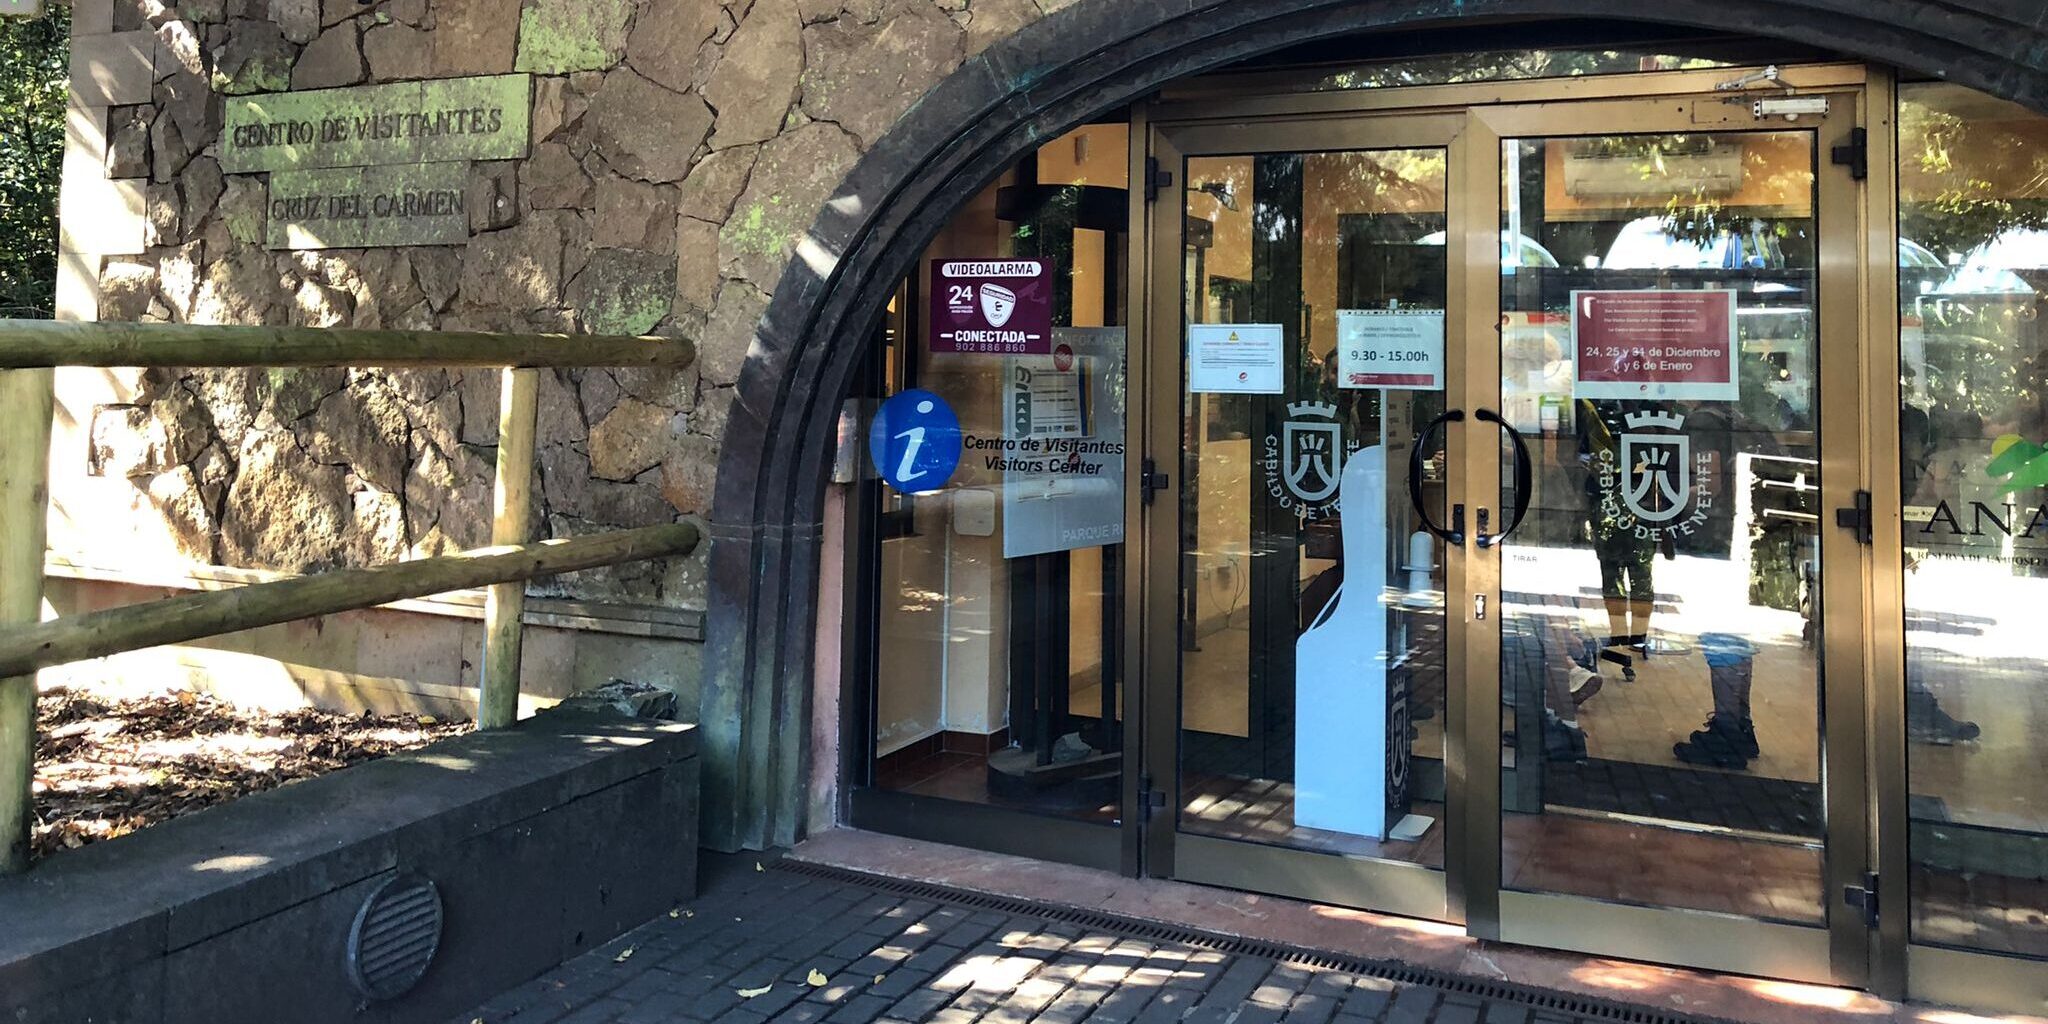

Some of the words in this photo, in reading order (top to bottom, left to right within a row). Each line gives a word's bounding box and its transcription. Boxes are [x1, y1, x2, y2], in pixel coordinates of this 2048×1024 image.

[233, 120, 314, 147] CENTRO
[320, 117, 348, 143] DE
[355, 107, 503, 140] VISITANTES
[271, 195, 323, 222] CRUZ
[327, 192, 369, 219] DEL
[372, 189, 466, 219] CARMEN
[949, 263, 1034, 275] VIDEOALARMA
[948, 285, 974, 305] 24
[955, 330, 1026, 343] CONECTADA
[955, 343, 975, 351] 902
[980, 343, 1000, 352] 886
[1005, 343, 1026, 352] 860
[1351, 350, 1377, 362] 9.30
[1387, 350, 1429, 362] 15.00h
[1606, 347, 1620, 357] 25
[1622, 349, 1629, 358] y
[1649, 347, 1662, 357] de
[1665, 347, 1721, 358] Diciembre
[1624, 363, 1631, 372] y
[1633, 361, 1641, 371] 6
[1643, 361, 1657, 371] de
[1660, 361, 1693, 371] Enero
[964, 435, 1016, 451] Centro
[1020, 437, 1039, 451] de
[1044, 437, 1124, 454] Visitantes
[985, 455, 1043, 472] Visitors
[1049, 458, 1103, 475] Center
[1265, 434, 1292, 509] CABILDO
[1294, 503, 1318, 520] DE
[1919, 499, 2048, 539] ANA
[1063, 525, 1109, 541] PARQUE
[1634, 524, 1663, 542] DE
[1512, 554, 1538, 563] TIRAR
